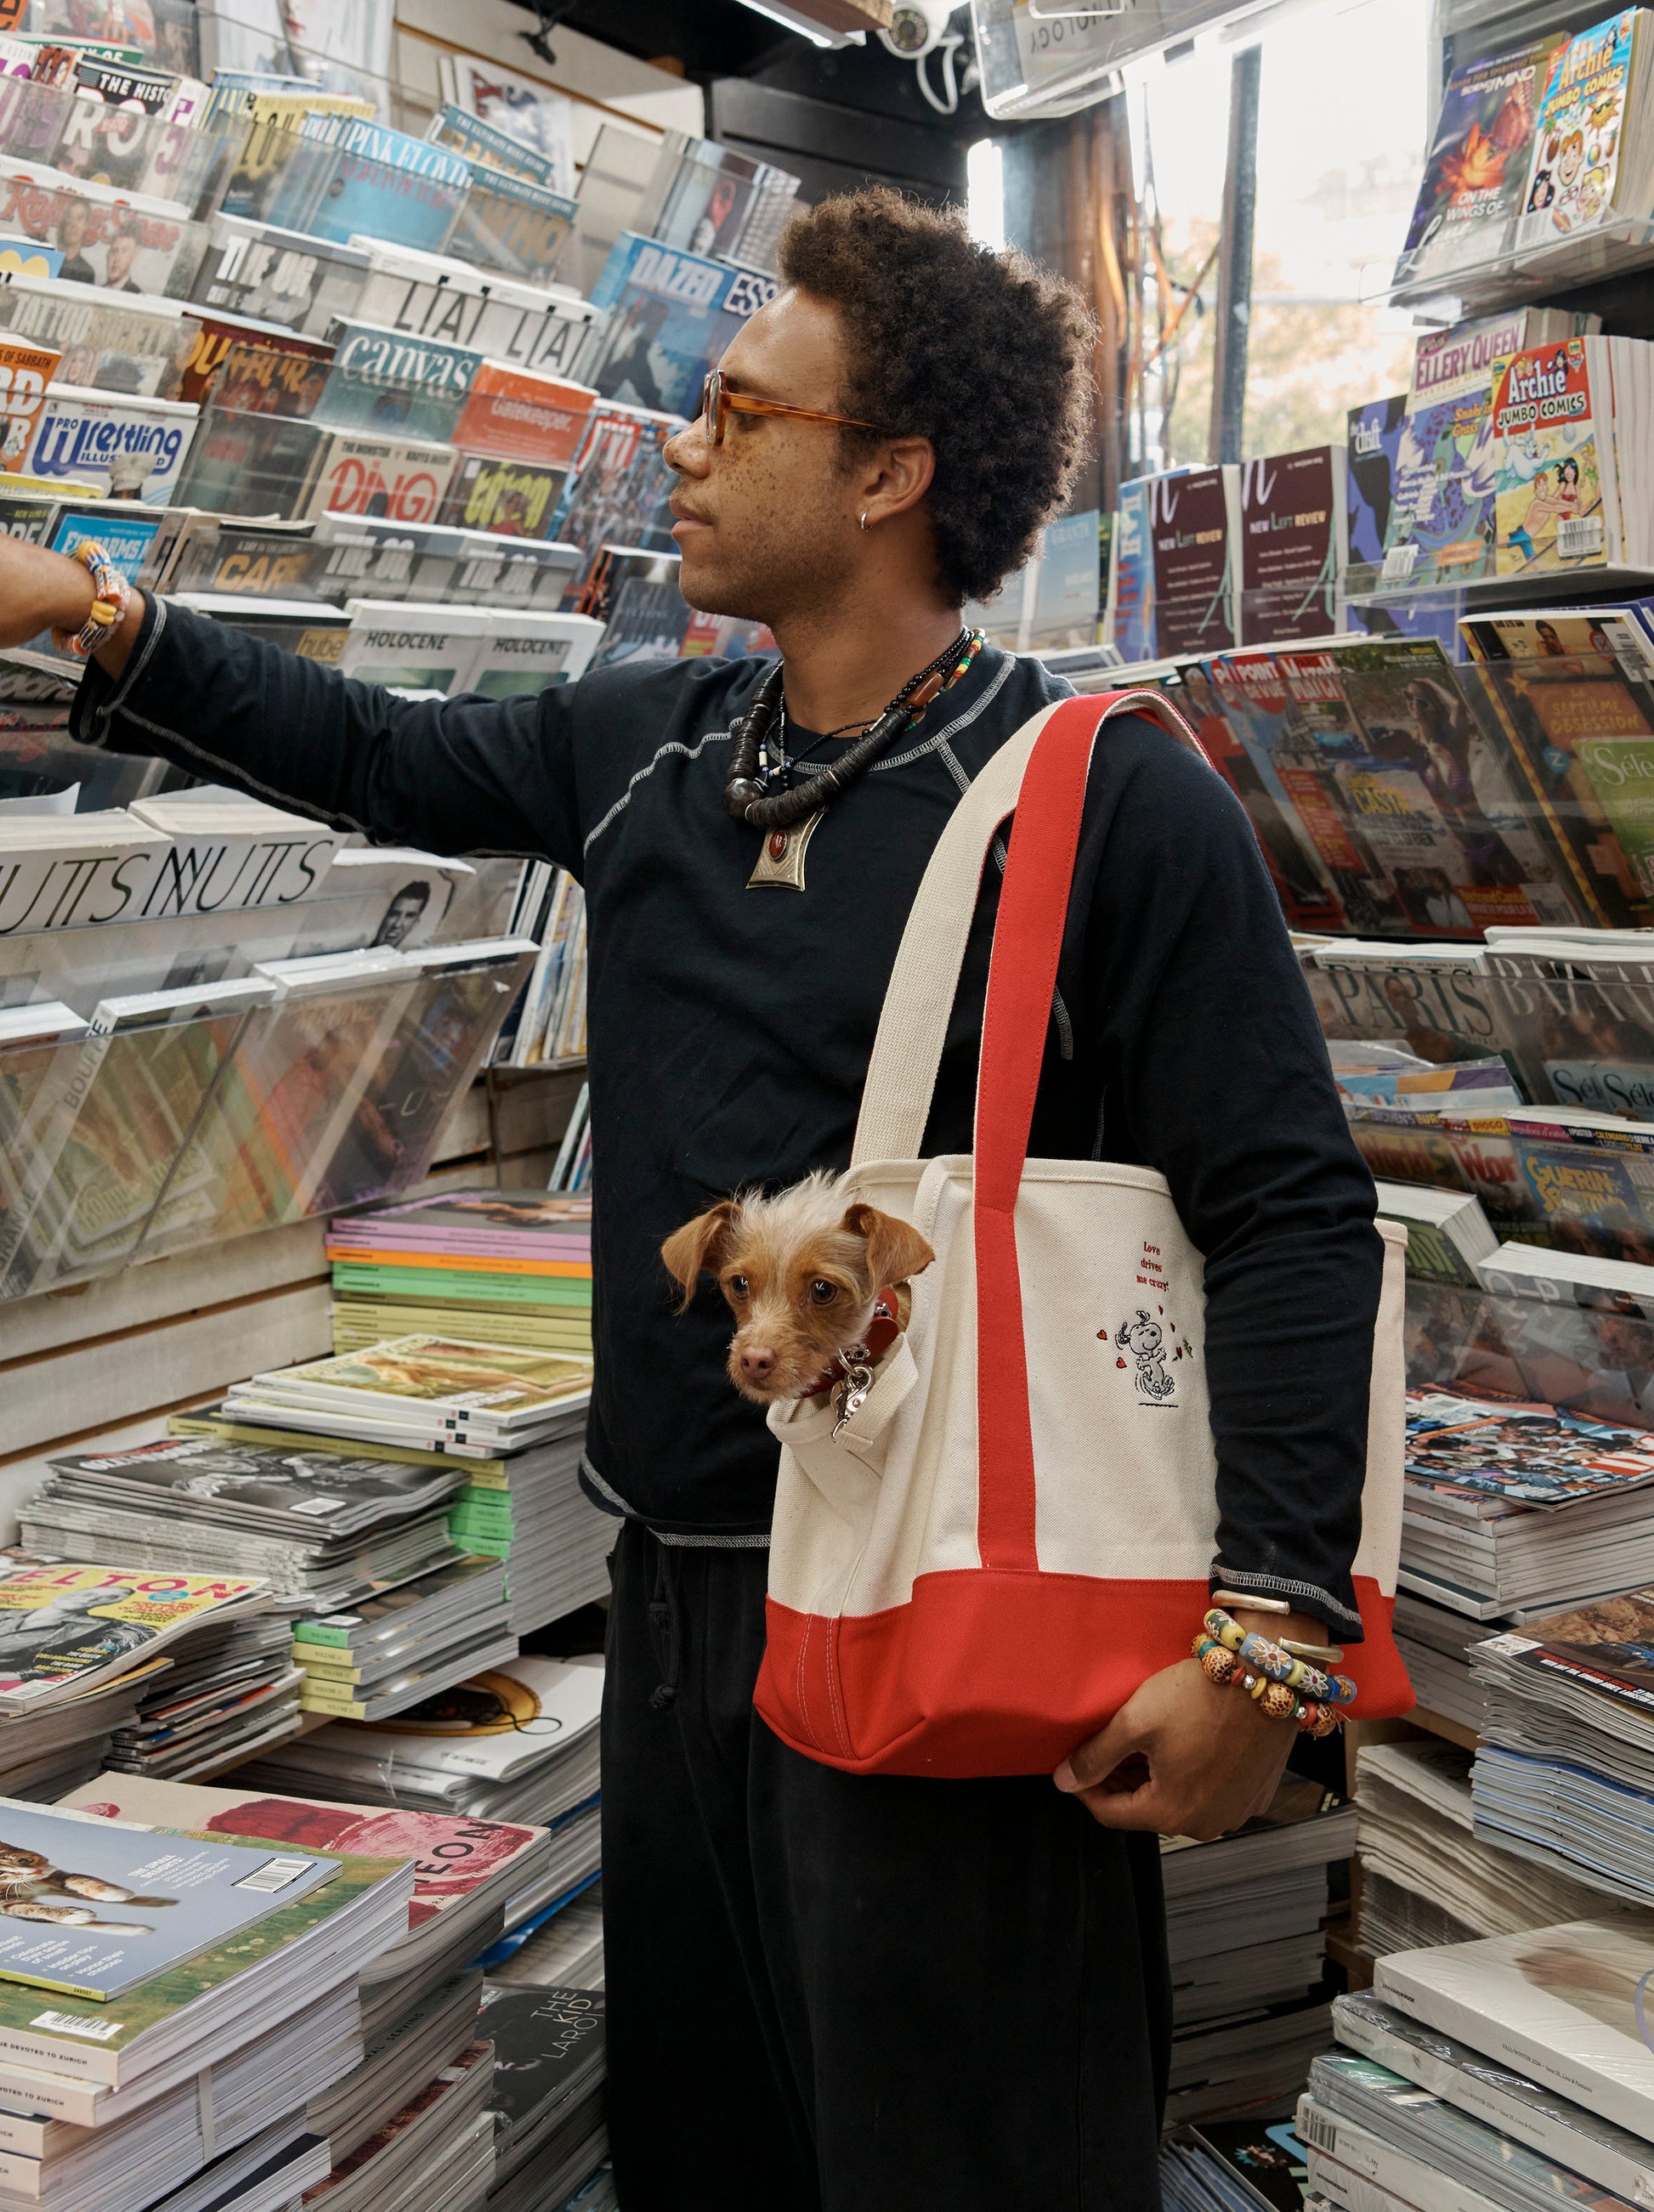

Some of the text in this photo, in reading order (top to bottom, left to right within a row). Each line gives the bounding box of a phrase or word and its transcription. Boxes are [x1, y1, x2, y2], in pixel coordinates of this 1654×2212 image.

[1558, 45, 1613, 92] Archie
[99, 73, 129, 98] THE
[1544, 63, 1625, 118] JUMBO COMICS
[345, 121, 473, 192] PINK FLOYD
[630, 246, 724, 303] DAZED
[14, 353, 53, 371] SABBATH
[1415, 321, 1521, 393] ELLERY QUEEN
[1508, 358, 1567, 405] Archie
[1498, 393, 1585, 428] JUMBO COMICS
[55, 417, 78, 430] PRO
[1249, 519, 1271, 535] NEW
[1294, 510, 1327, 528] REVIEW
[1158, 537, 1175, 552] NEW
[1196, 529, 1223, 545] REVIEW
[364, 631, 450, 651] HOLOCENE
[491, 638, 565, 657] HOLOCENE
[1237, 662, 1279, 680] POINT
[1549, 715, 1641, 736] OBSESSION
[1471, 1120, 1504, 1130] DIOGO
[1143, 1241, 1162, 1256] Love
[1140, 1258, 1163, 1274] drives
[1136, 1274, 1170, 1293] me crazy!
[10, 1570, 251, 1602] ELTON
[530, 1990, 578, 2018] THE
[554, 1998, 592, 2024] KID
[387, 2011, 425, 2043] SERVING
[10, 2043, 46, 2056] DEVOTED
[47, 2051, 58, 2060] TO
[59, 2054, 88, 2066] ZURICH
[25, 2092, 36, 2101] TO
[37, 2095, 65, 2107] ZURICH
